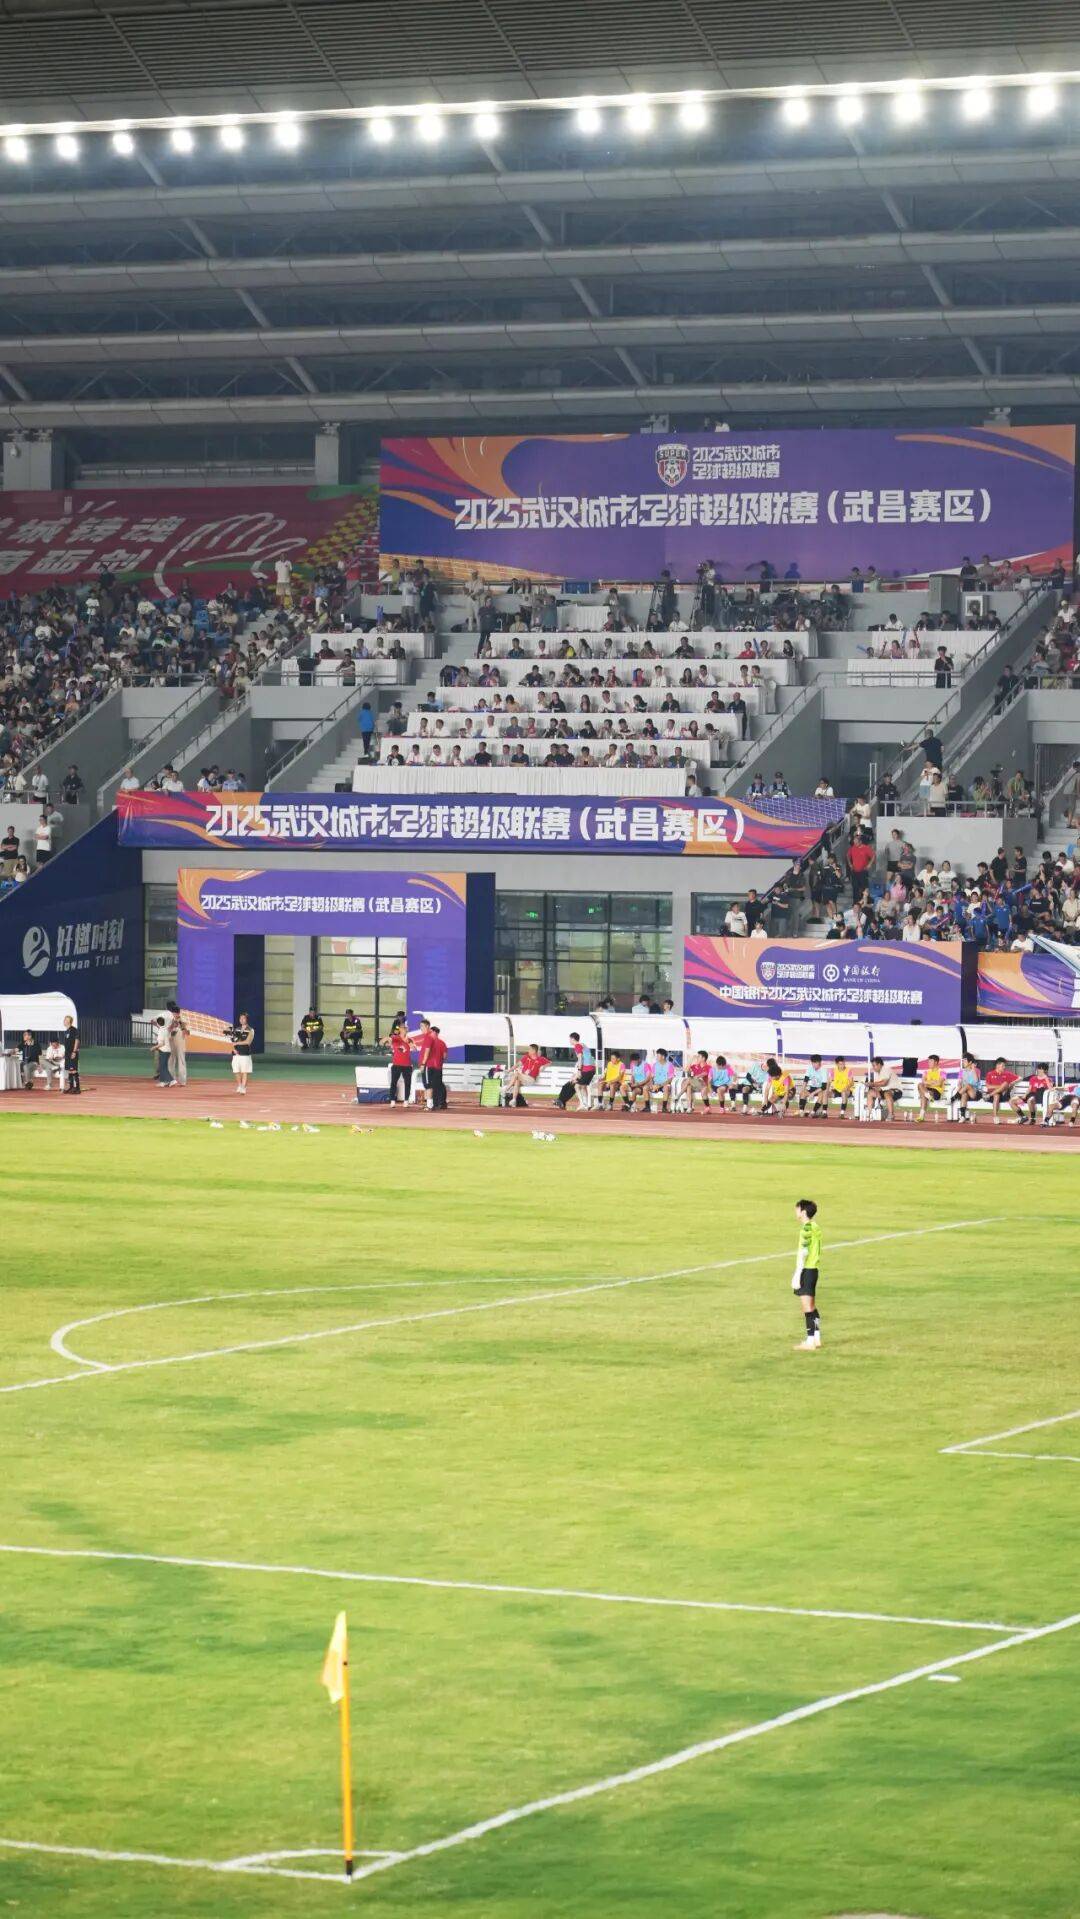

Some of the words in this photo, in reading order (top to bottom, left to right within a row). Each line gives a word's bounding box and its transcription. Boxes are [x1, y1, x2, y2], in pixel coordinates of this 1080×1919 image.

[692, 444, 780, 462] 2025武汉城市
[692, 461, 780, 480] 足球超级联赛
[454, 488, 992, 530] 2025武汉城市足球超级联赛（武昌赛区）
[206, 804, 745, 842] 2025武汉城市足球超级联赛（武昌赛区）
[201, 894, 442, 914] 2025武汉城市足球超级联赛（武昌赛区）
[56, 918, 124, 957] 好燃时刻
[719, 985, 923, 1005] 中国银行2025武汉城市足球超级联赛
